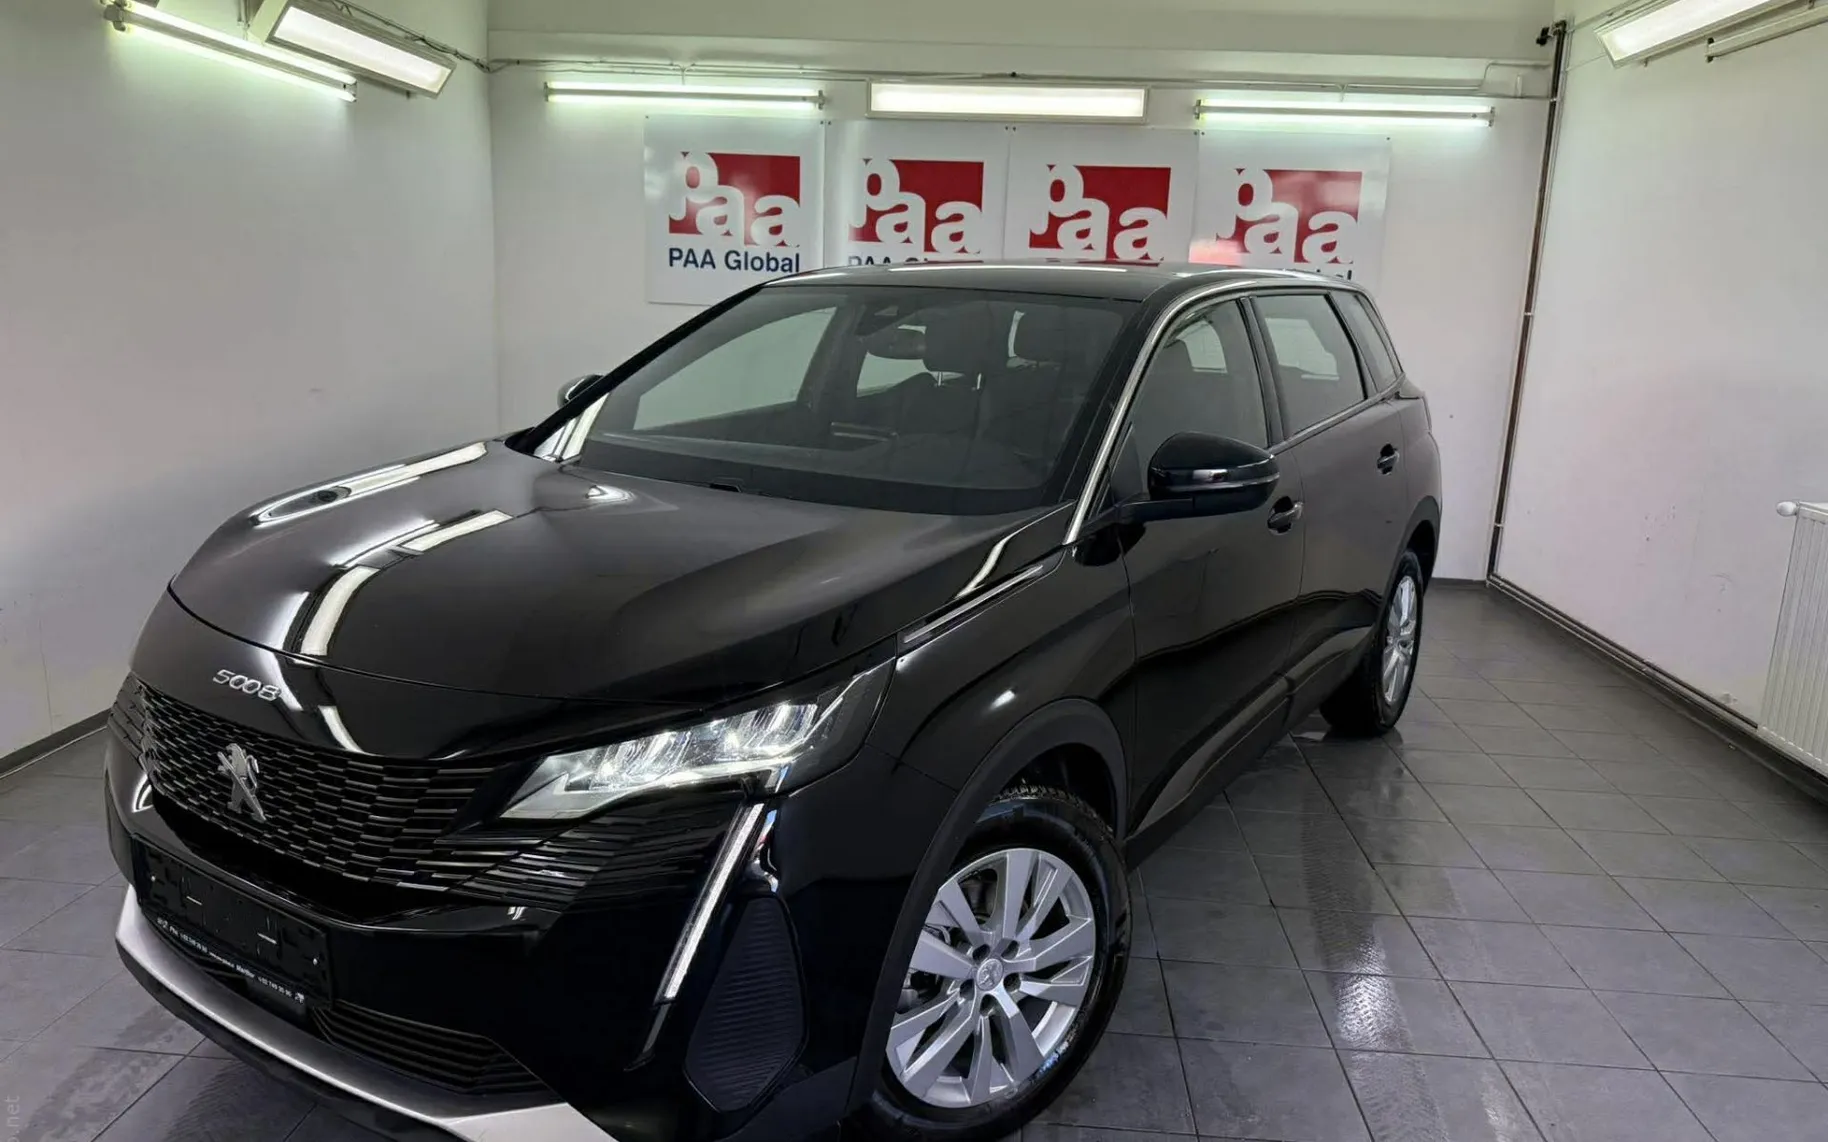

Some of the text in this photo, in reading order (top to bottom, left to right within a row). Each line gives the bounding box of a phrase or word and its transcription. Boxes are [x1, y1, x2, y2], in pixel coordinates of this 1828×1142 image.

[668, 248, 801, 273] PAA Global
[212, 669, 282, 702] 5008
